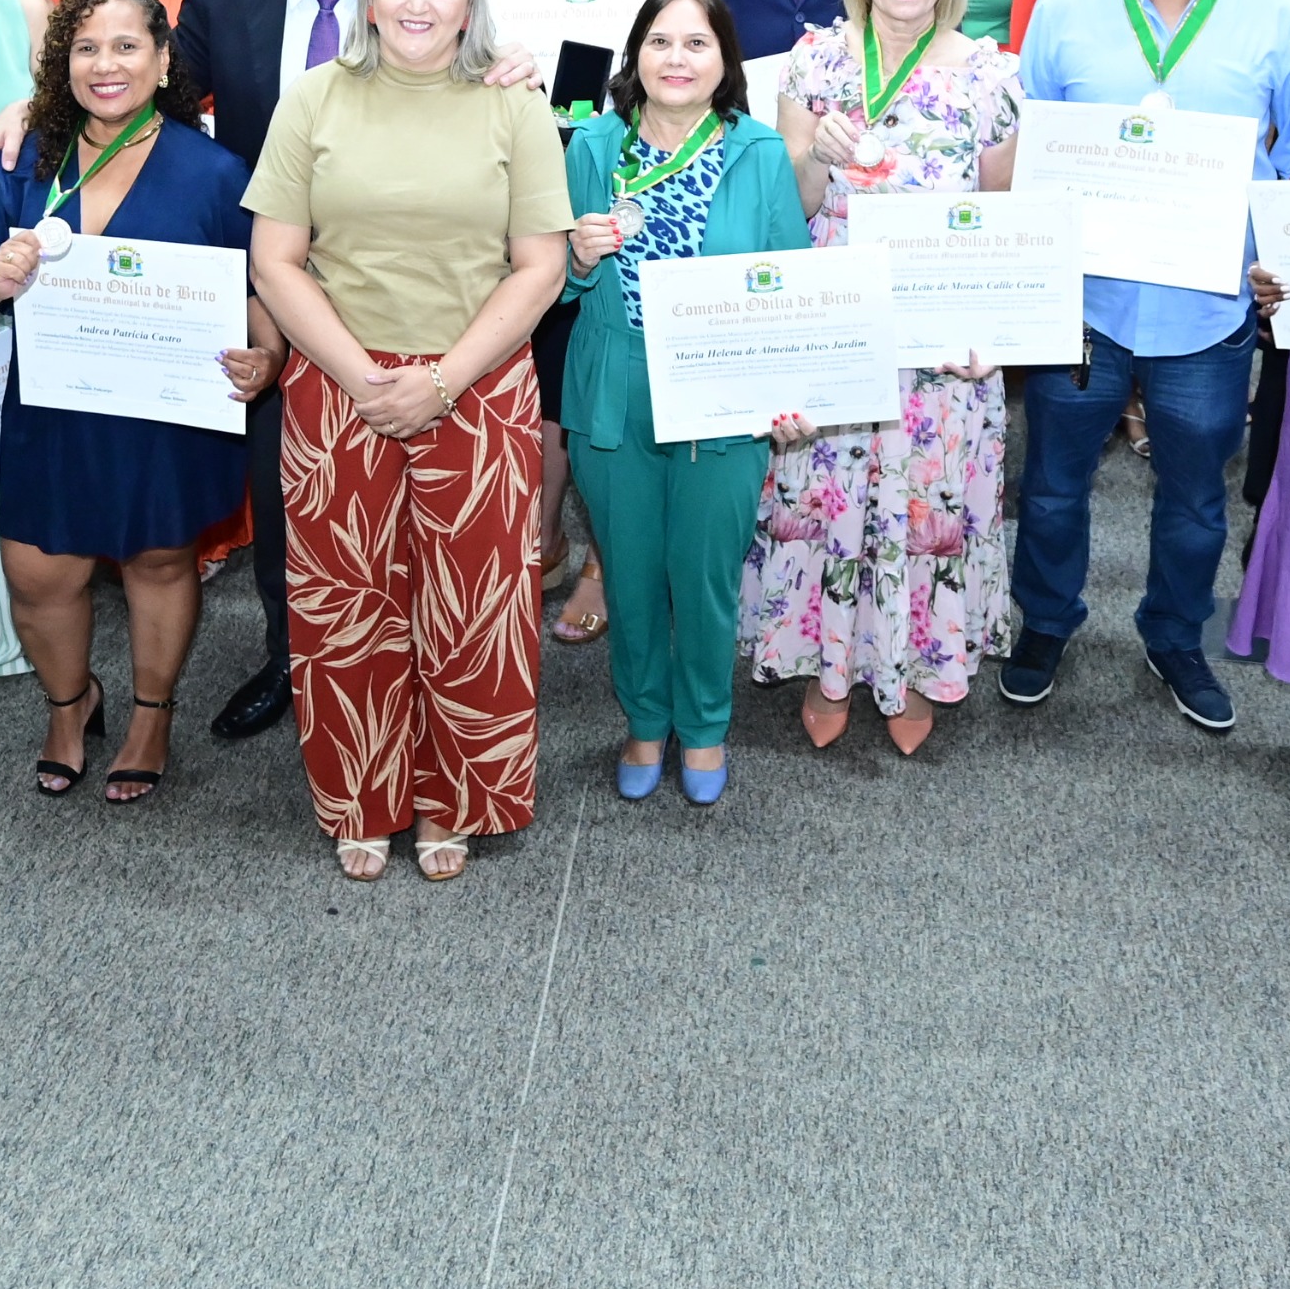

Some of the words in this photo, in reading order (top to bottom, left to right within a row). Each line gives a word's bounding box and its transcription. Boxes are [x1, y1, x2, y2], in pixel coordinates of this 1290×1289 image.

[876, 235, 941, 250] omenda
[995, 234, 1010, 247] de
[1016, 232, 1054, 248] Brito
[39, 272, 102, 292] Comenda
[157, 284, 171, 299] de
[177, 284, 216, 303] Brito
[892, 283, 909, 292] átia
[912, 282, 935, 292] Leite
[937, 282, 948, 291] de
[953, 281, 983, 290] Morais
[987, 280, 1014, 290] Calile
[1017, 281, 1046, 289] Coura
[672, 300, 740, 318] Comenda
[798, 294, 814, 308] de
[820, 290, 861, 308] Brito
[77, 324, 110, 336] Andrea
[152, 332, 182, 343] Castro
[676, 351, 704, 361] Maria
[708, 348, 743, 358] Helena
[746, 346, 757, 356] de
[762, 344, 800, 354] Almeida
[803, 342, 829, 352] Alves
[832, 339, 867, 350] Jardim
